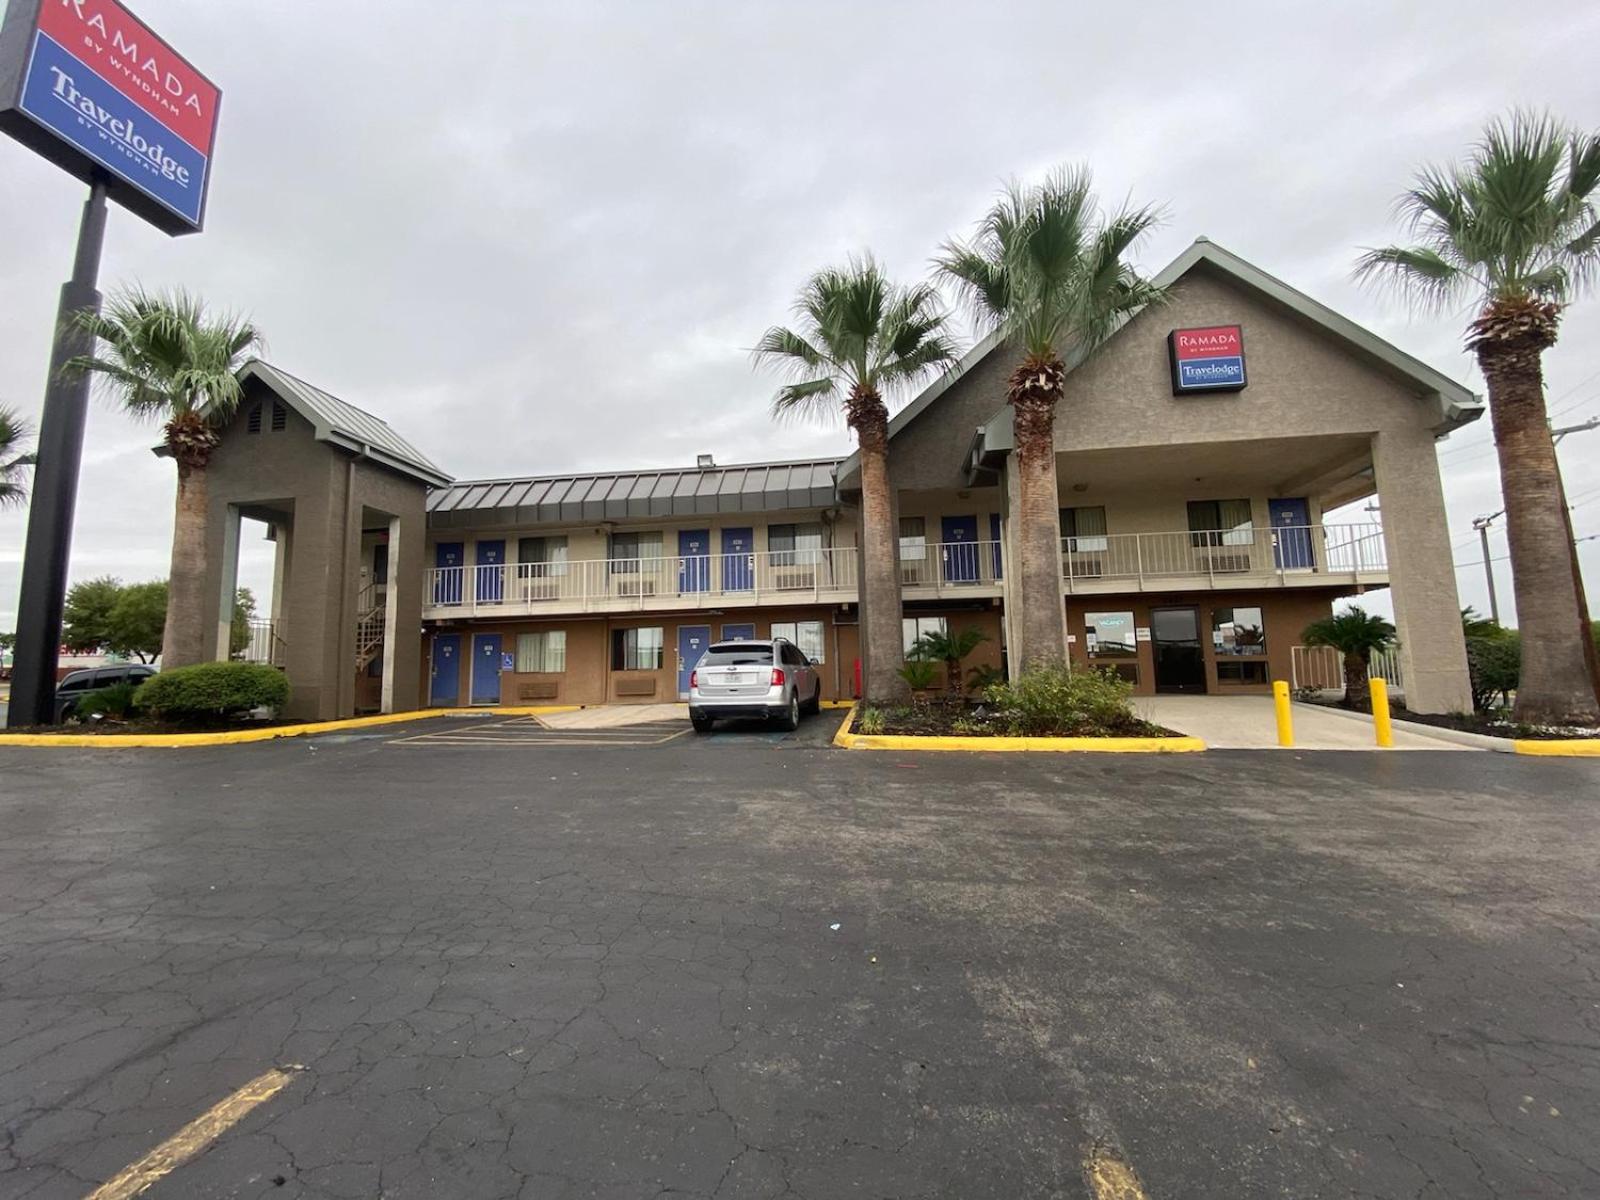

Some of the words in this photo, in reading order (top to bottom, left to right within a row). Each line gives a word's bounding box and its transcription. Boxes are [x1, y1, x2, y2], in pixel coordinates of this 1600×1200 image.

[84, 36, 103, 53] BY
[110, 55, 180, 116] WYNDHAM
[51, 66, 190, 183] Travelodge
[78, 116, 92, 129] BY
[98, 130, 159, 176] WYNDHAM
[1180, 335, 1236, 347] RAMADA
[1183, 364, 1240, 377] Travelodge
